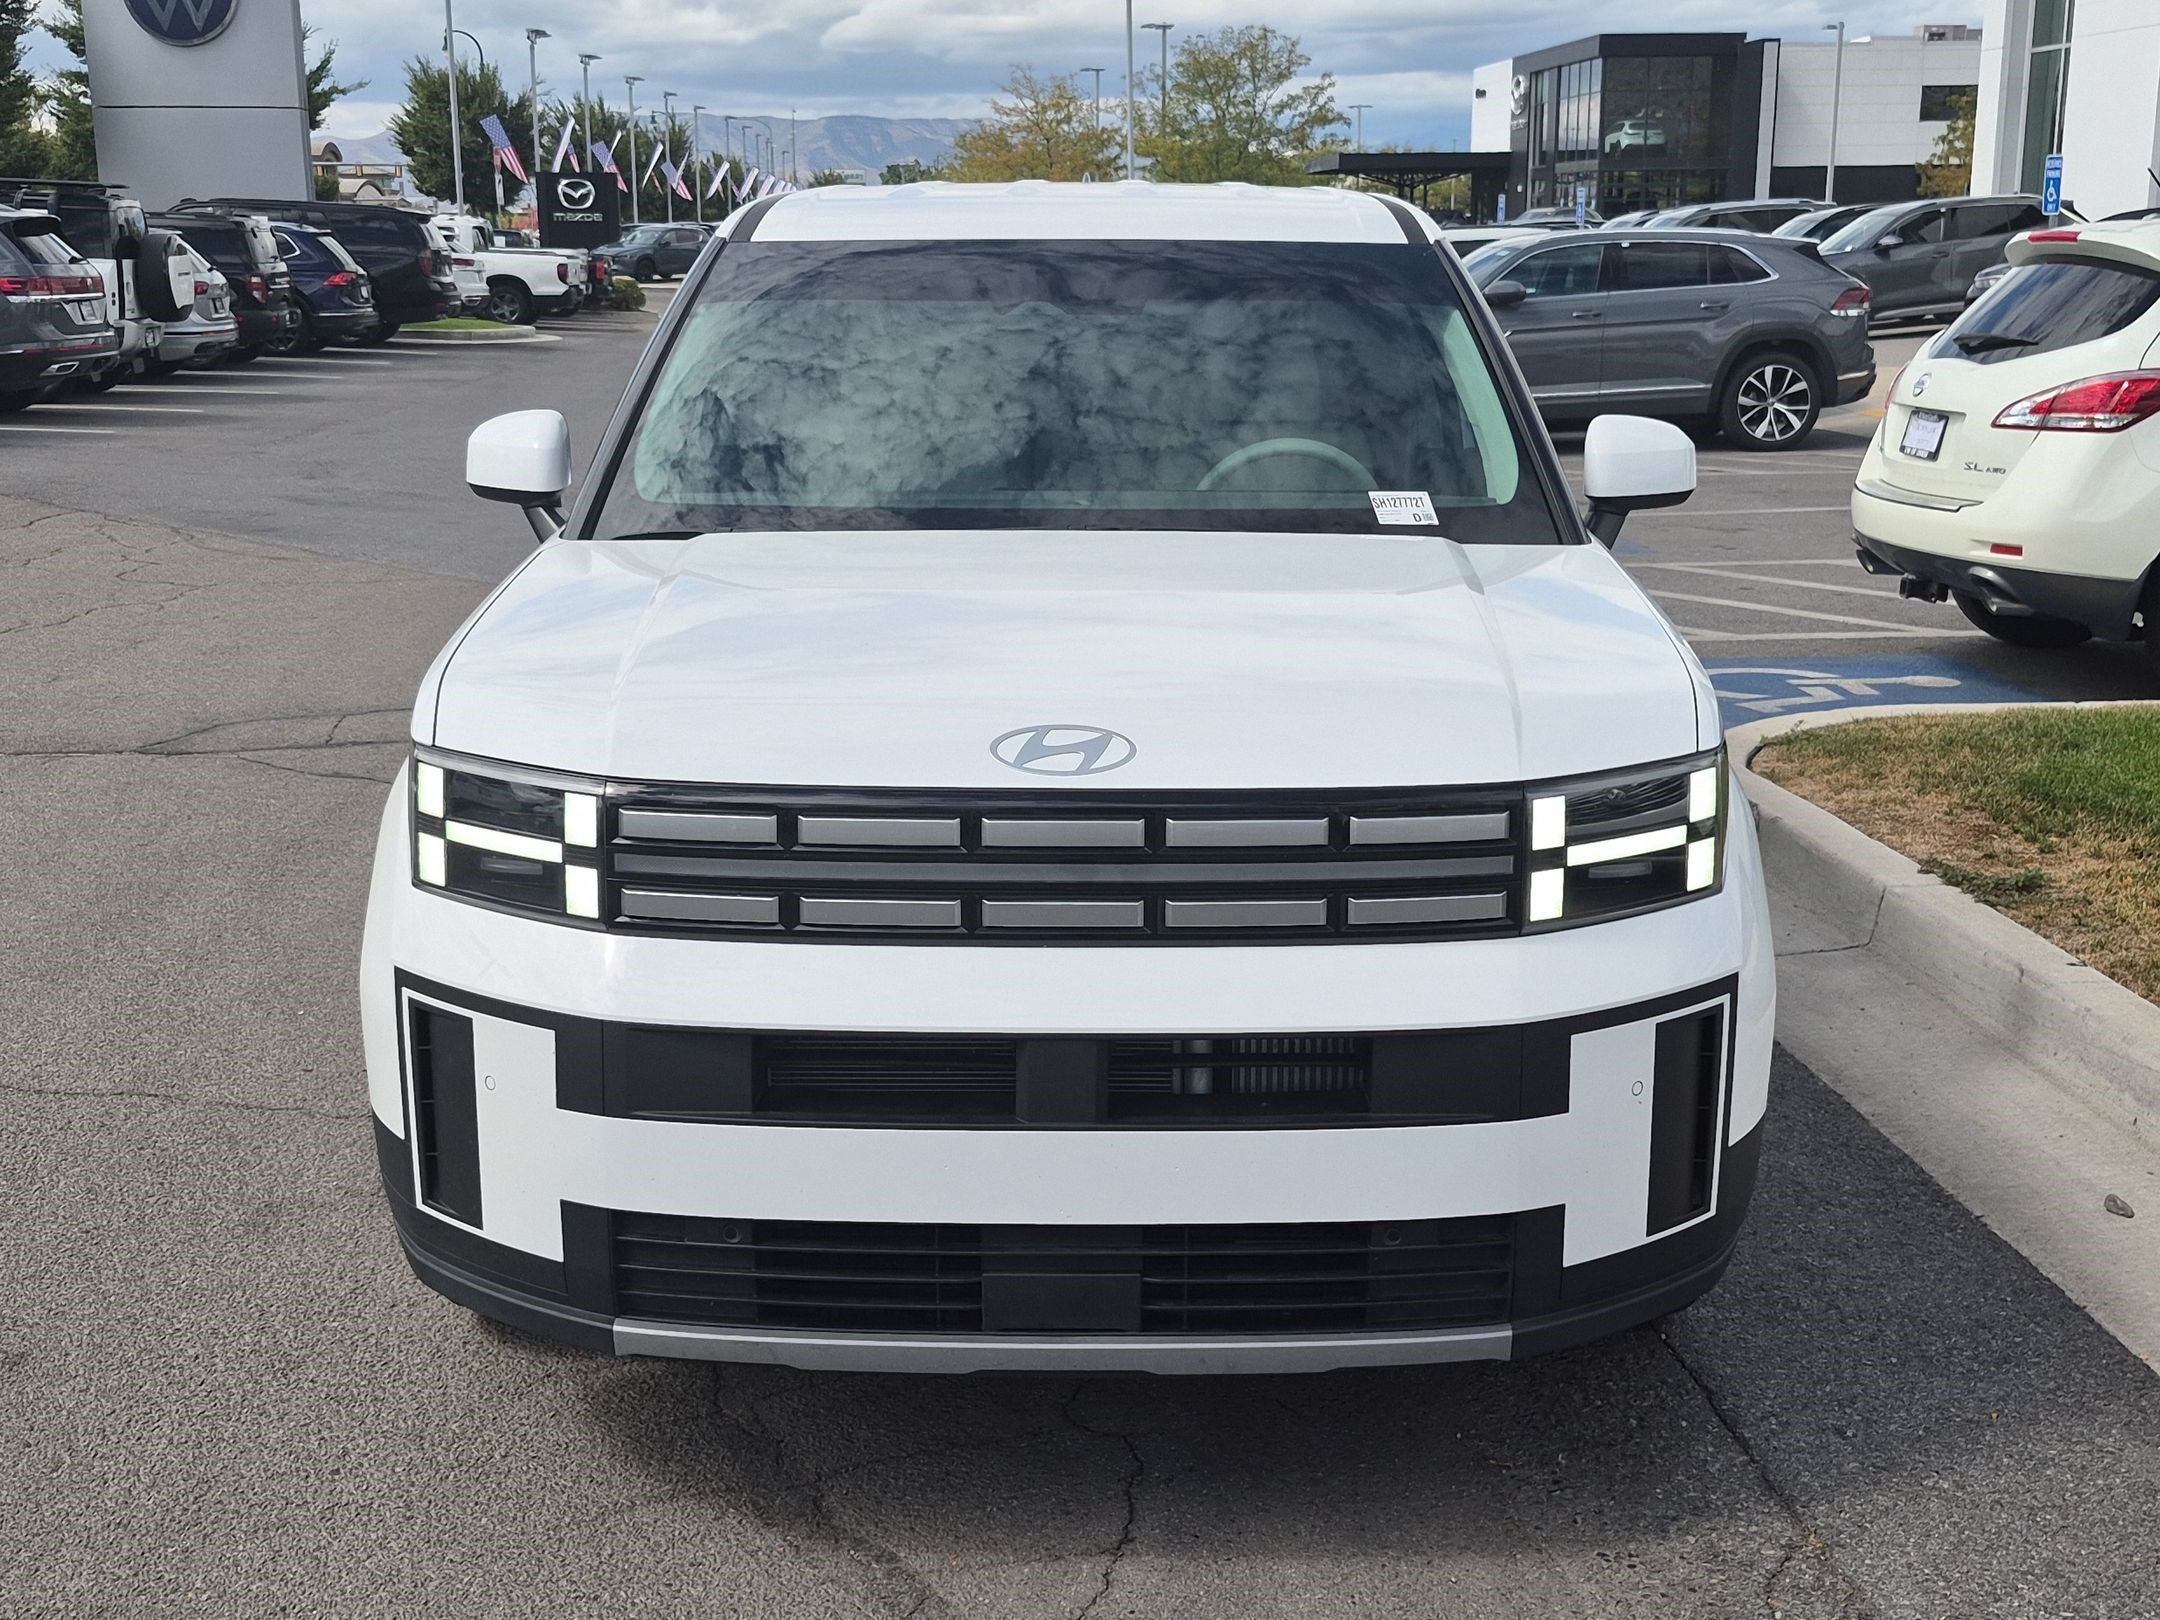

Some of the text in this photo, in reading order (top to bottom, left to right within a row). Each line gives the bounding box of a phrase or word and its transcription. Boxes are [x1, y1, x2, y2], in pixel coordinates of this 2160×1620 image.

[1963, 461, 1983, 472] SL
[1372, 497, 1425, 509] SH127772T
[1412, 513, 1422, 522] D
